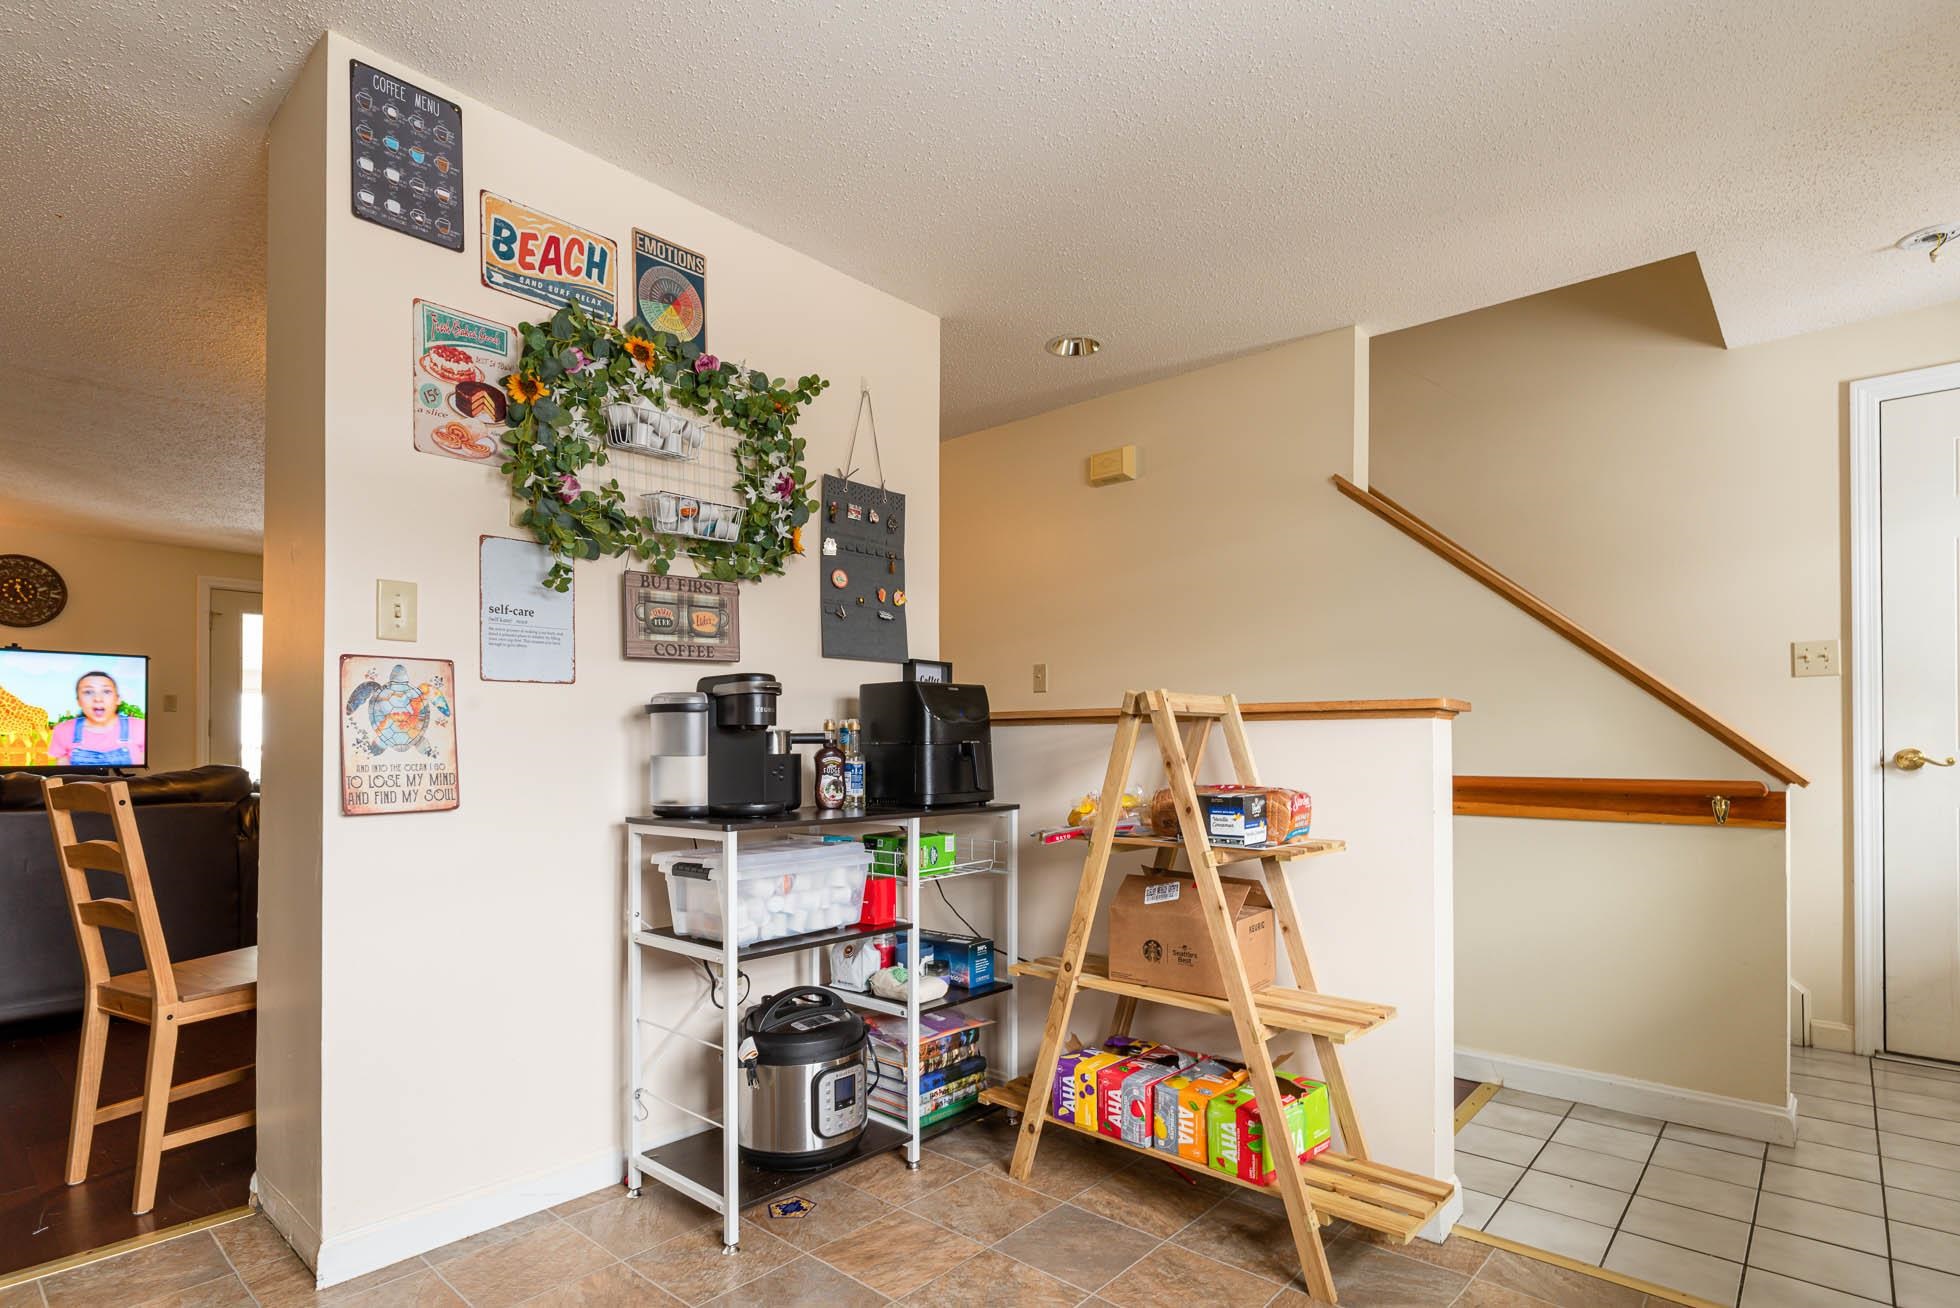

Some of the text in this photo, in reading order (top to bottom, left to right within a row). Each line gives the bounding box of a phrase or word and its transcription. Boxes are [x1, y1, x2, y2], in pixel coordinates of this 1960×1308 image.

[372, 74, 440, 117] COFFEE MENU
[491, 216, 608, 286] BEACH
[636, 233, 704, 274] EMOTIONS
[520, 277, 602, 307] SAND SURF RELAX
[425, 408, 449, 418] slice
[640, 574, 724, 595] BUT FIRST
[488, 604, 535, 617] self-care
[654, 643, 715, 658] COFFEE
[346, 772, 456, 789] TO LOSE MY MIND
[356, 764, 369, 773] AND
[371, 764, 388, 773] INTO
[390, 764, 400, 772] THE
[404, 763, 427, 772] OCEAN
[348, 788, 456, 806] AND FIND MY SOUL
[1062, 1075, 1075, 1113] AHA
[1108, 1089, 1122, 1128] AHA
[1178, 1105, 1194, 1145] AHA
[1220, 1122, 1237, 1163] AHA
